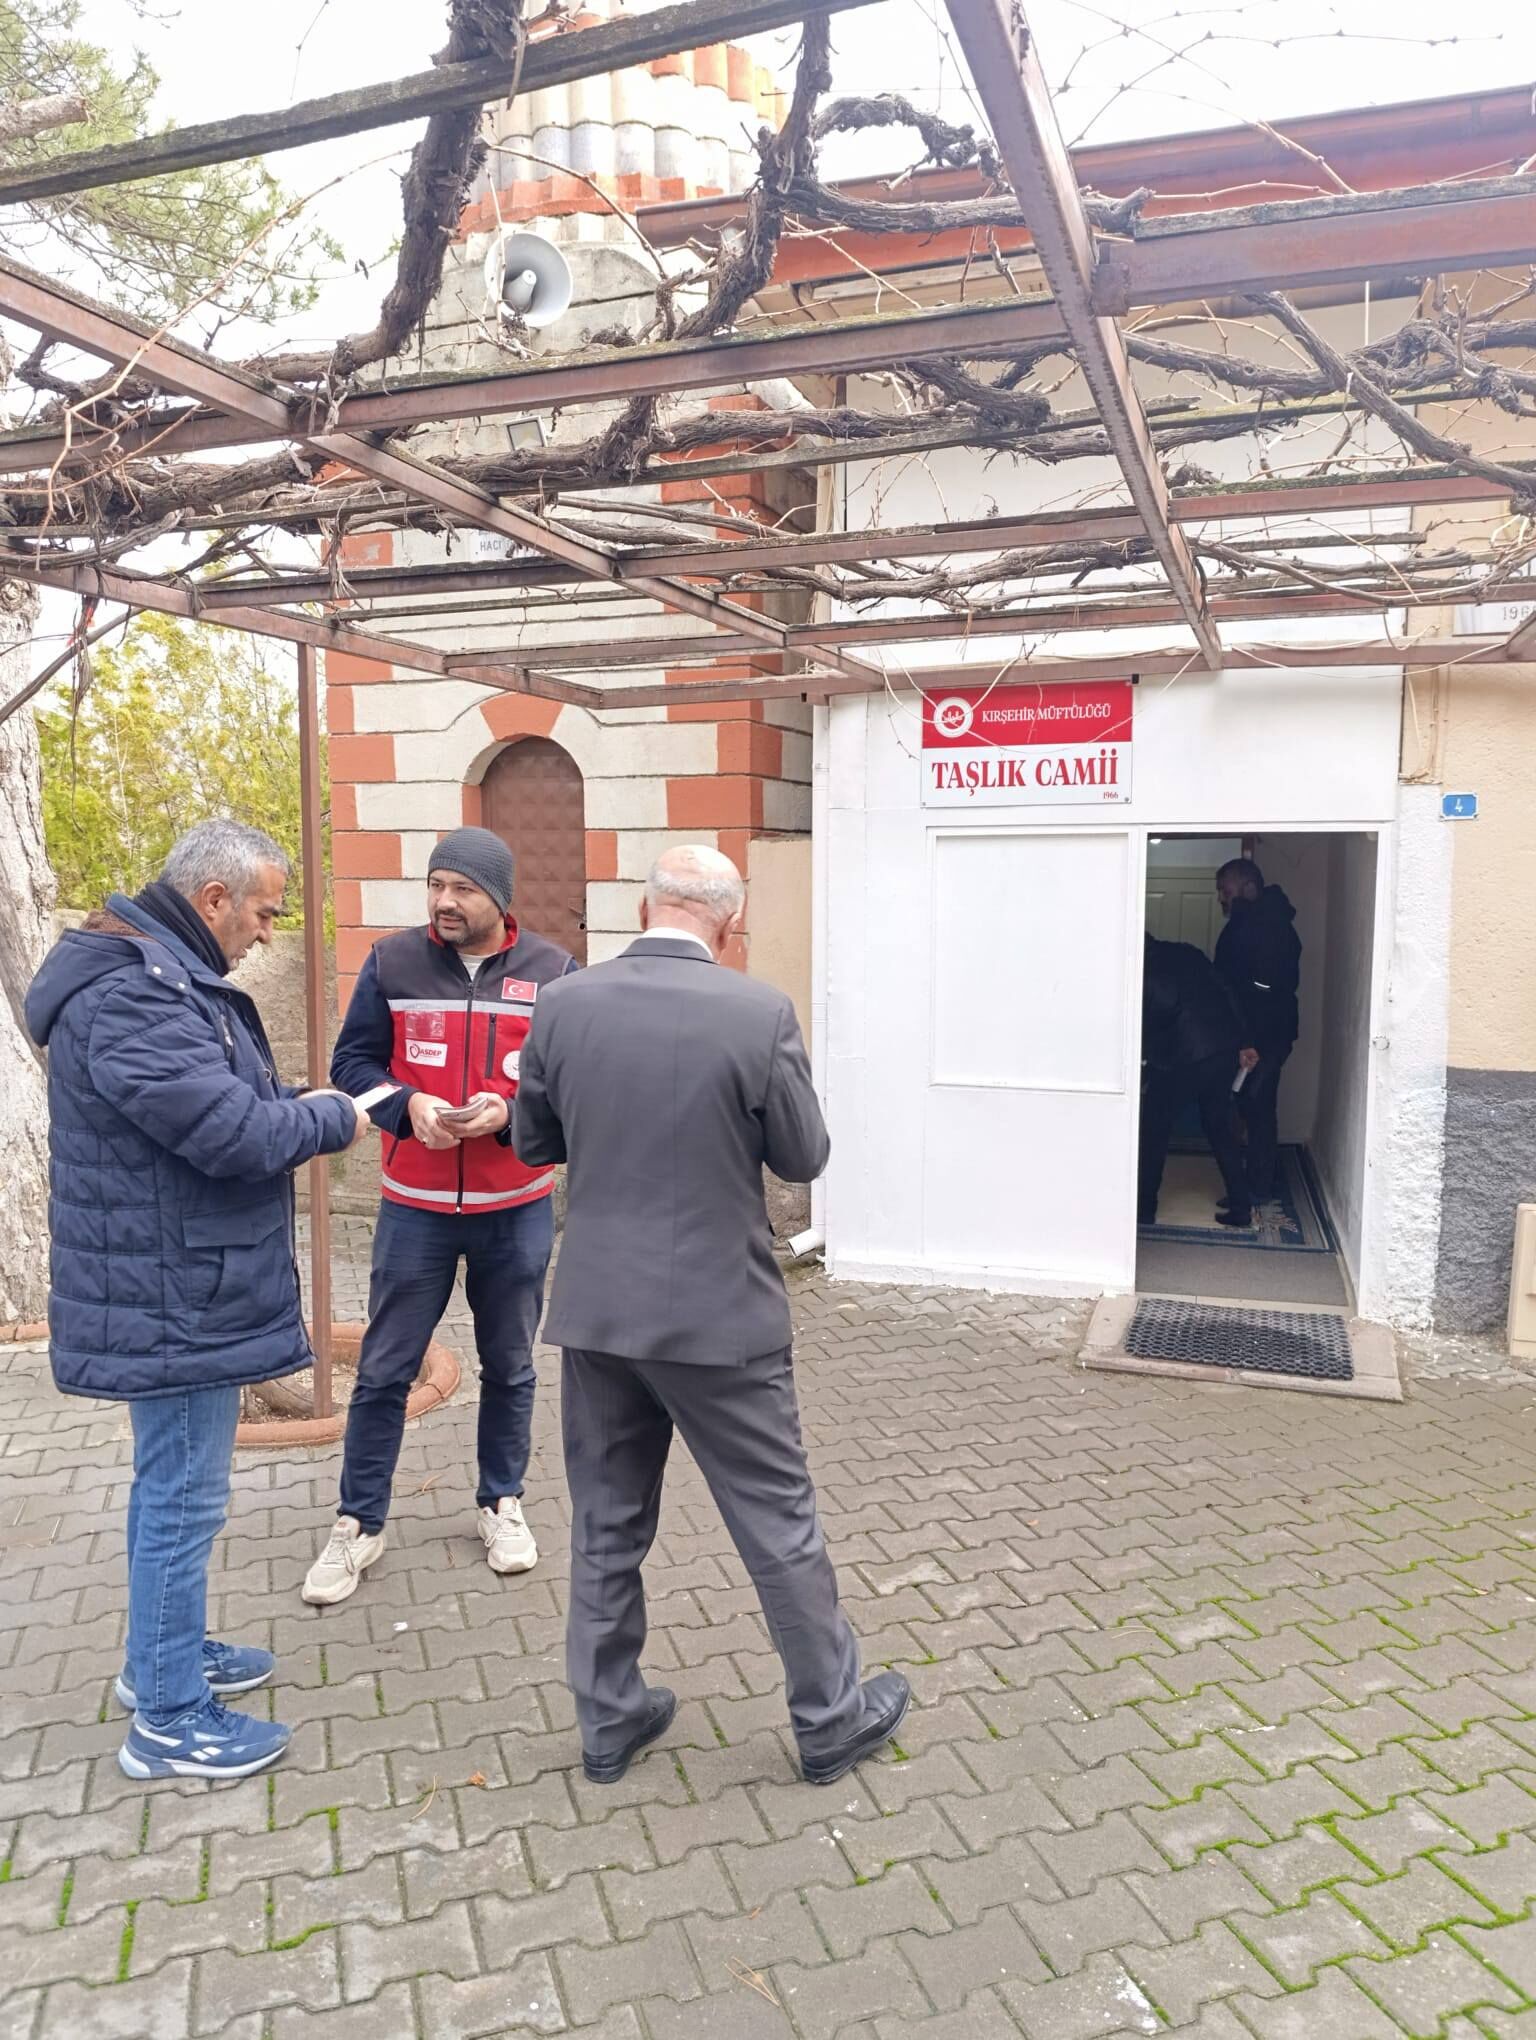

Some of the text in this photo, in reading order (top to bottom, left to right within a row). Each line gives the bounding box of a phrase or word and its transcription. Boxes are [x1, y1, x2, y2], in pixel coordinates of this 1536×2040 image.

[1503, 605, 1536, 620] 196
[982, 703, 1111, 724] KIRŞEHİR MÜFTÜLÜĞÜ
[932, 748, 1119, 796] TAŞLIK CAMİİ
[1103, 791, 1119, 799] 1966
[1454, 798, 1463, 813] 4
[420, 1048, 442, 1056] ASDEP
